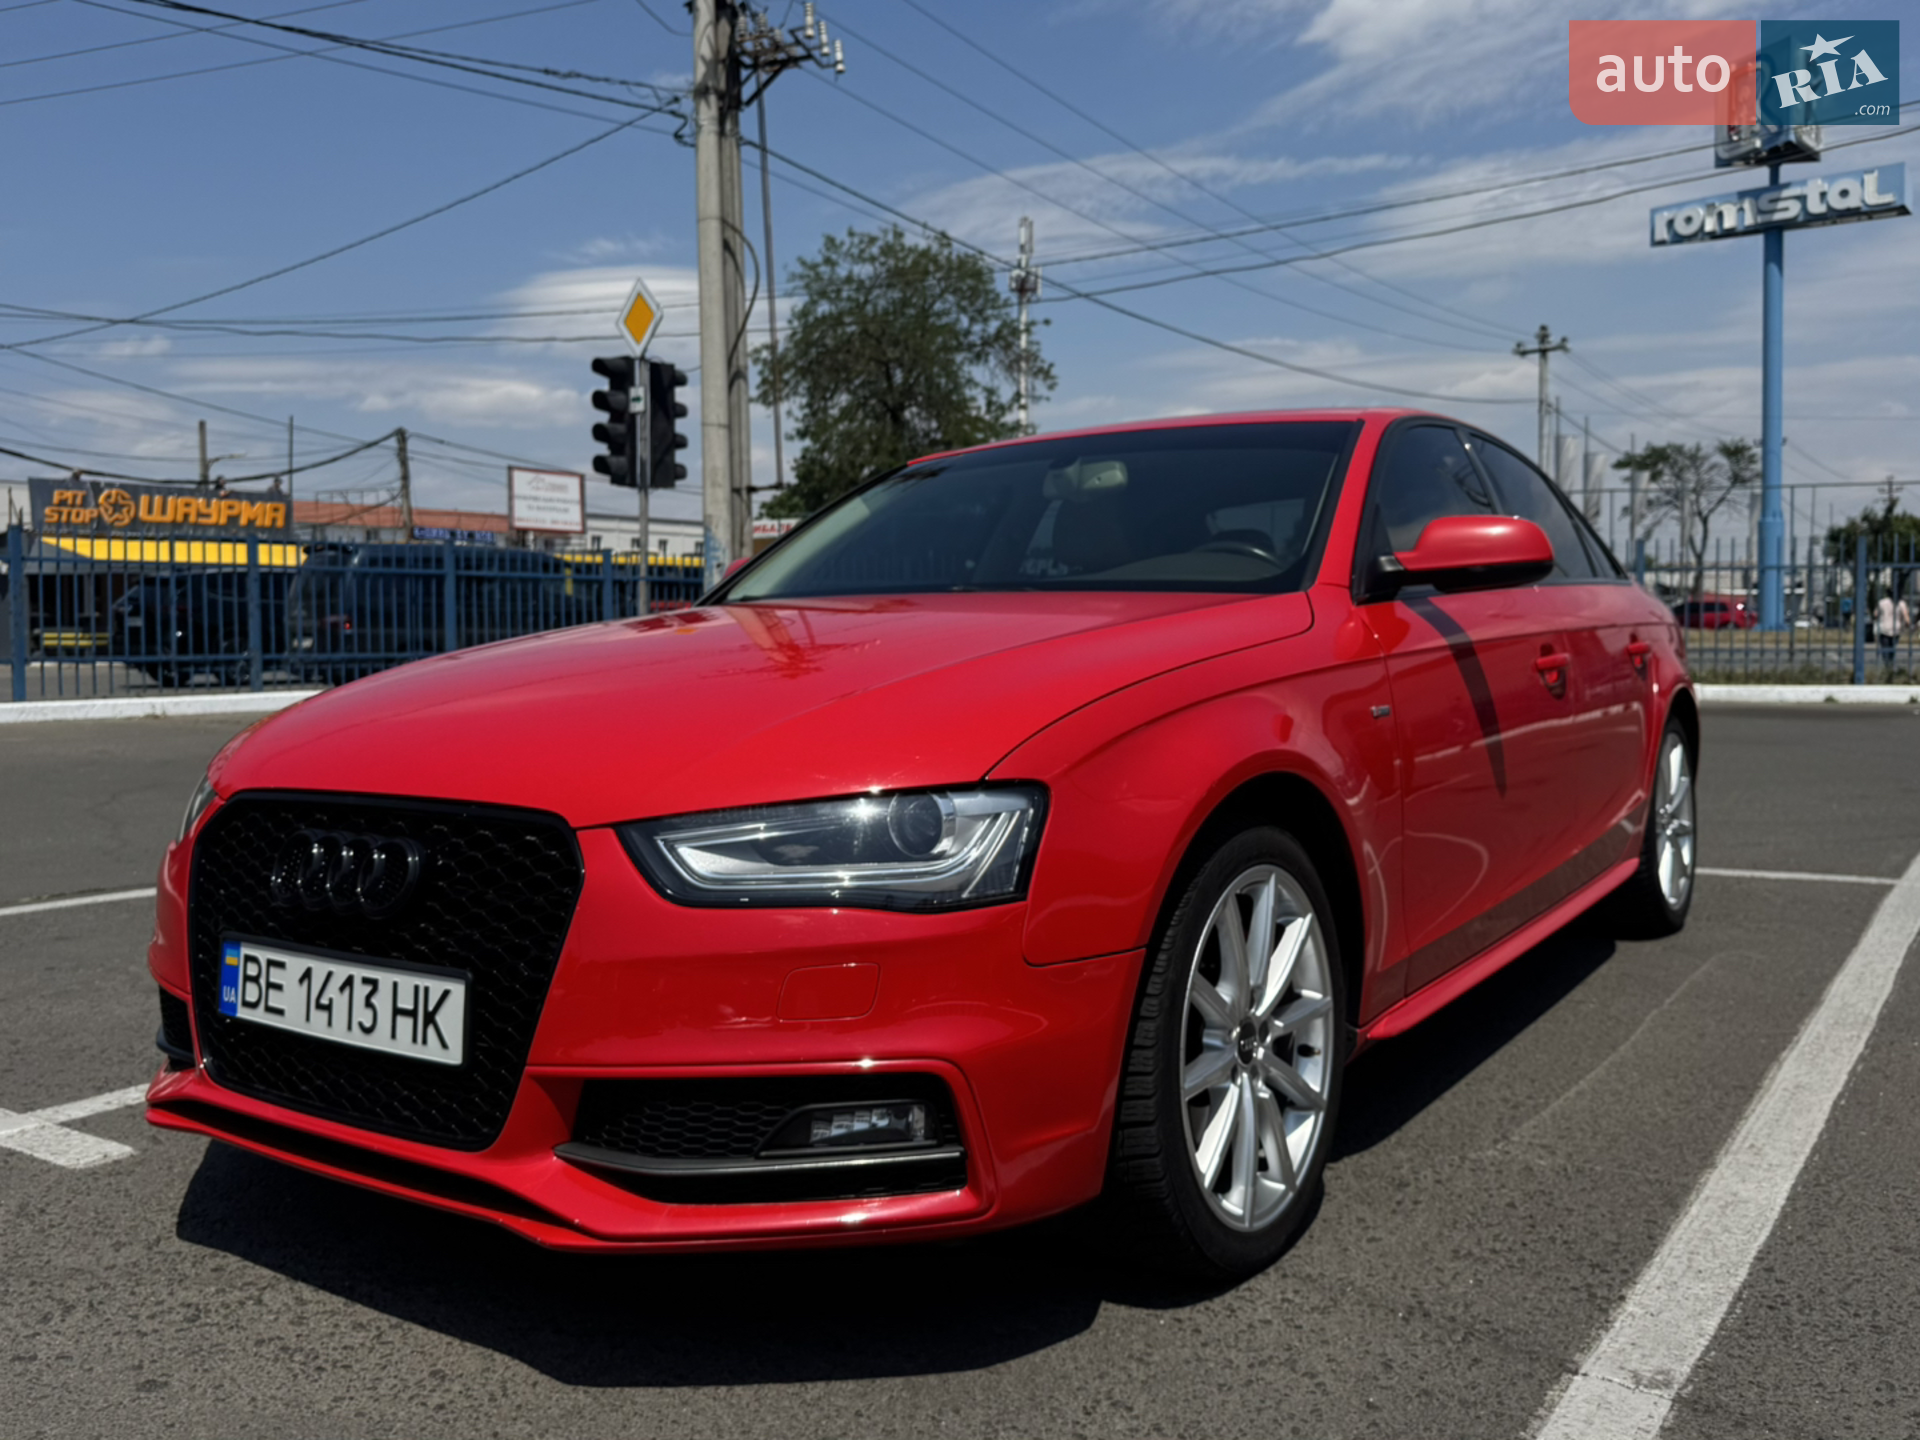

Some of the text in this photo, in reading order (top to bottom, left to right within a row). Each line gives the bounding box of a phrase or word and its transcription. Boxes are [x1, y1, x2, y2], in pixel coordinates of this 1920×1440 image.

[53, 489, 87, 506] PIT
[44, 506, 100, 525] STOP
[139, 493, 287, 528] ШАУРМА
[223, 985, 237, 1004] UA
[241, 953, 452, 1050] BE 1413 HK
